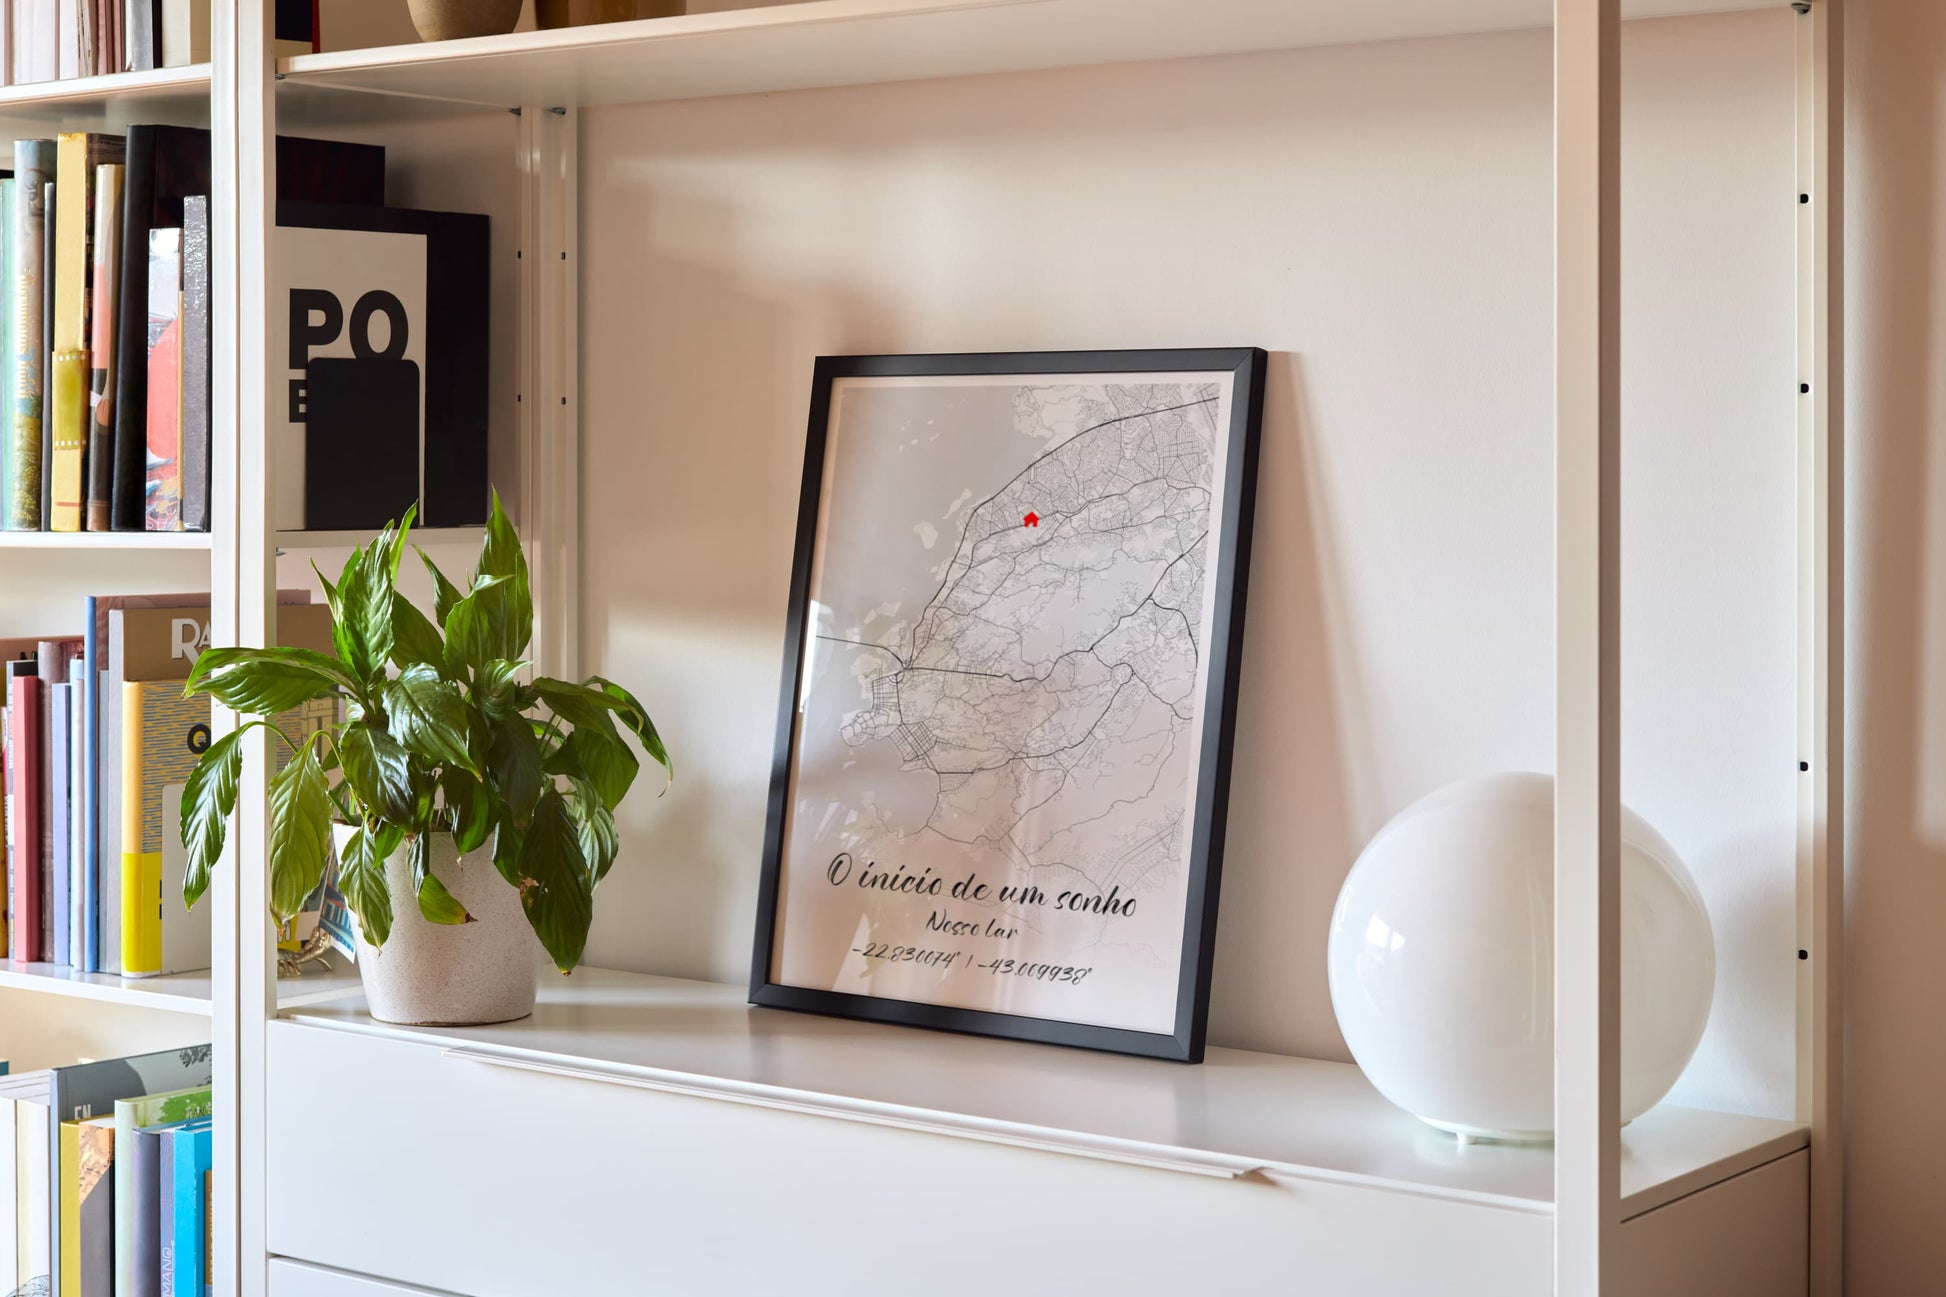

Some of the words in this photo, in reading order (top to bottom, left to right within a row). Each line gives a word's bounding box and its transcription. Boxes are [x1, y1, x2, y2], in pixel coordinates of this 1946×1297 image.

[827, 852, 852, 886] O
[951, 872, 993, 901] de
[999, 885, 1050, 906] um
[1054, 885, 1137, 917] sonho
[925, 908, 981, 937] Nosso
[985, 918, 1018, 940] lar
